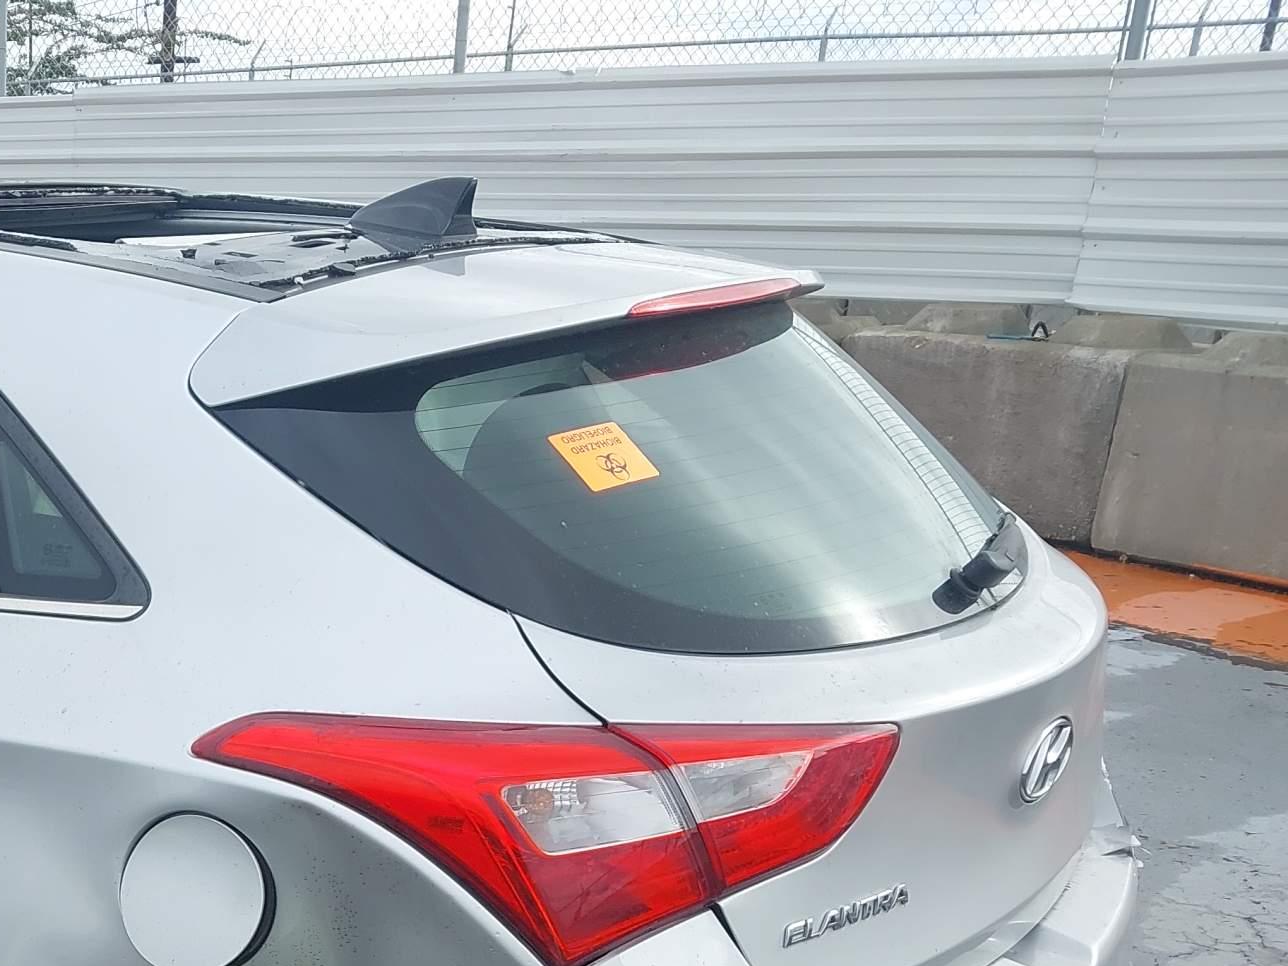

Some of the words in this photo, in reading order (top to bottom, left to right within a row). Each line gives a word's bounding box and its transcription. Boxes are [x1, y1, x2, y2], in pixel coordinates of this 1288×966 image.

[560, 426, 613, 444] BIOPELIGRO
[570, 436, 622, 455] BIOHAZARD
[782, 882, 909, 949] ELANTRA
